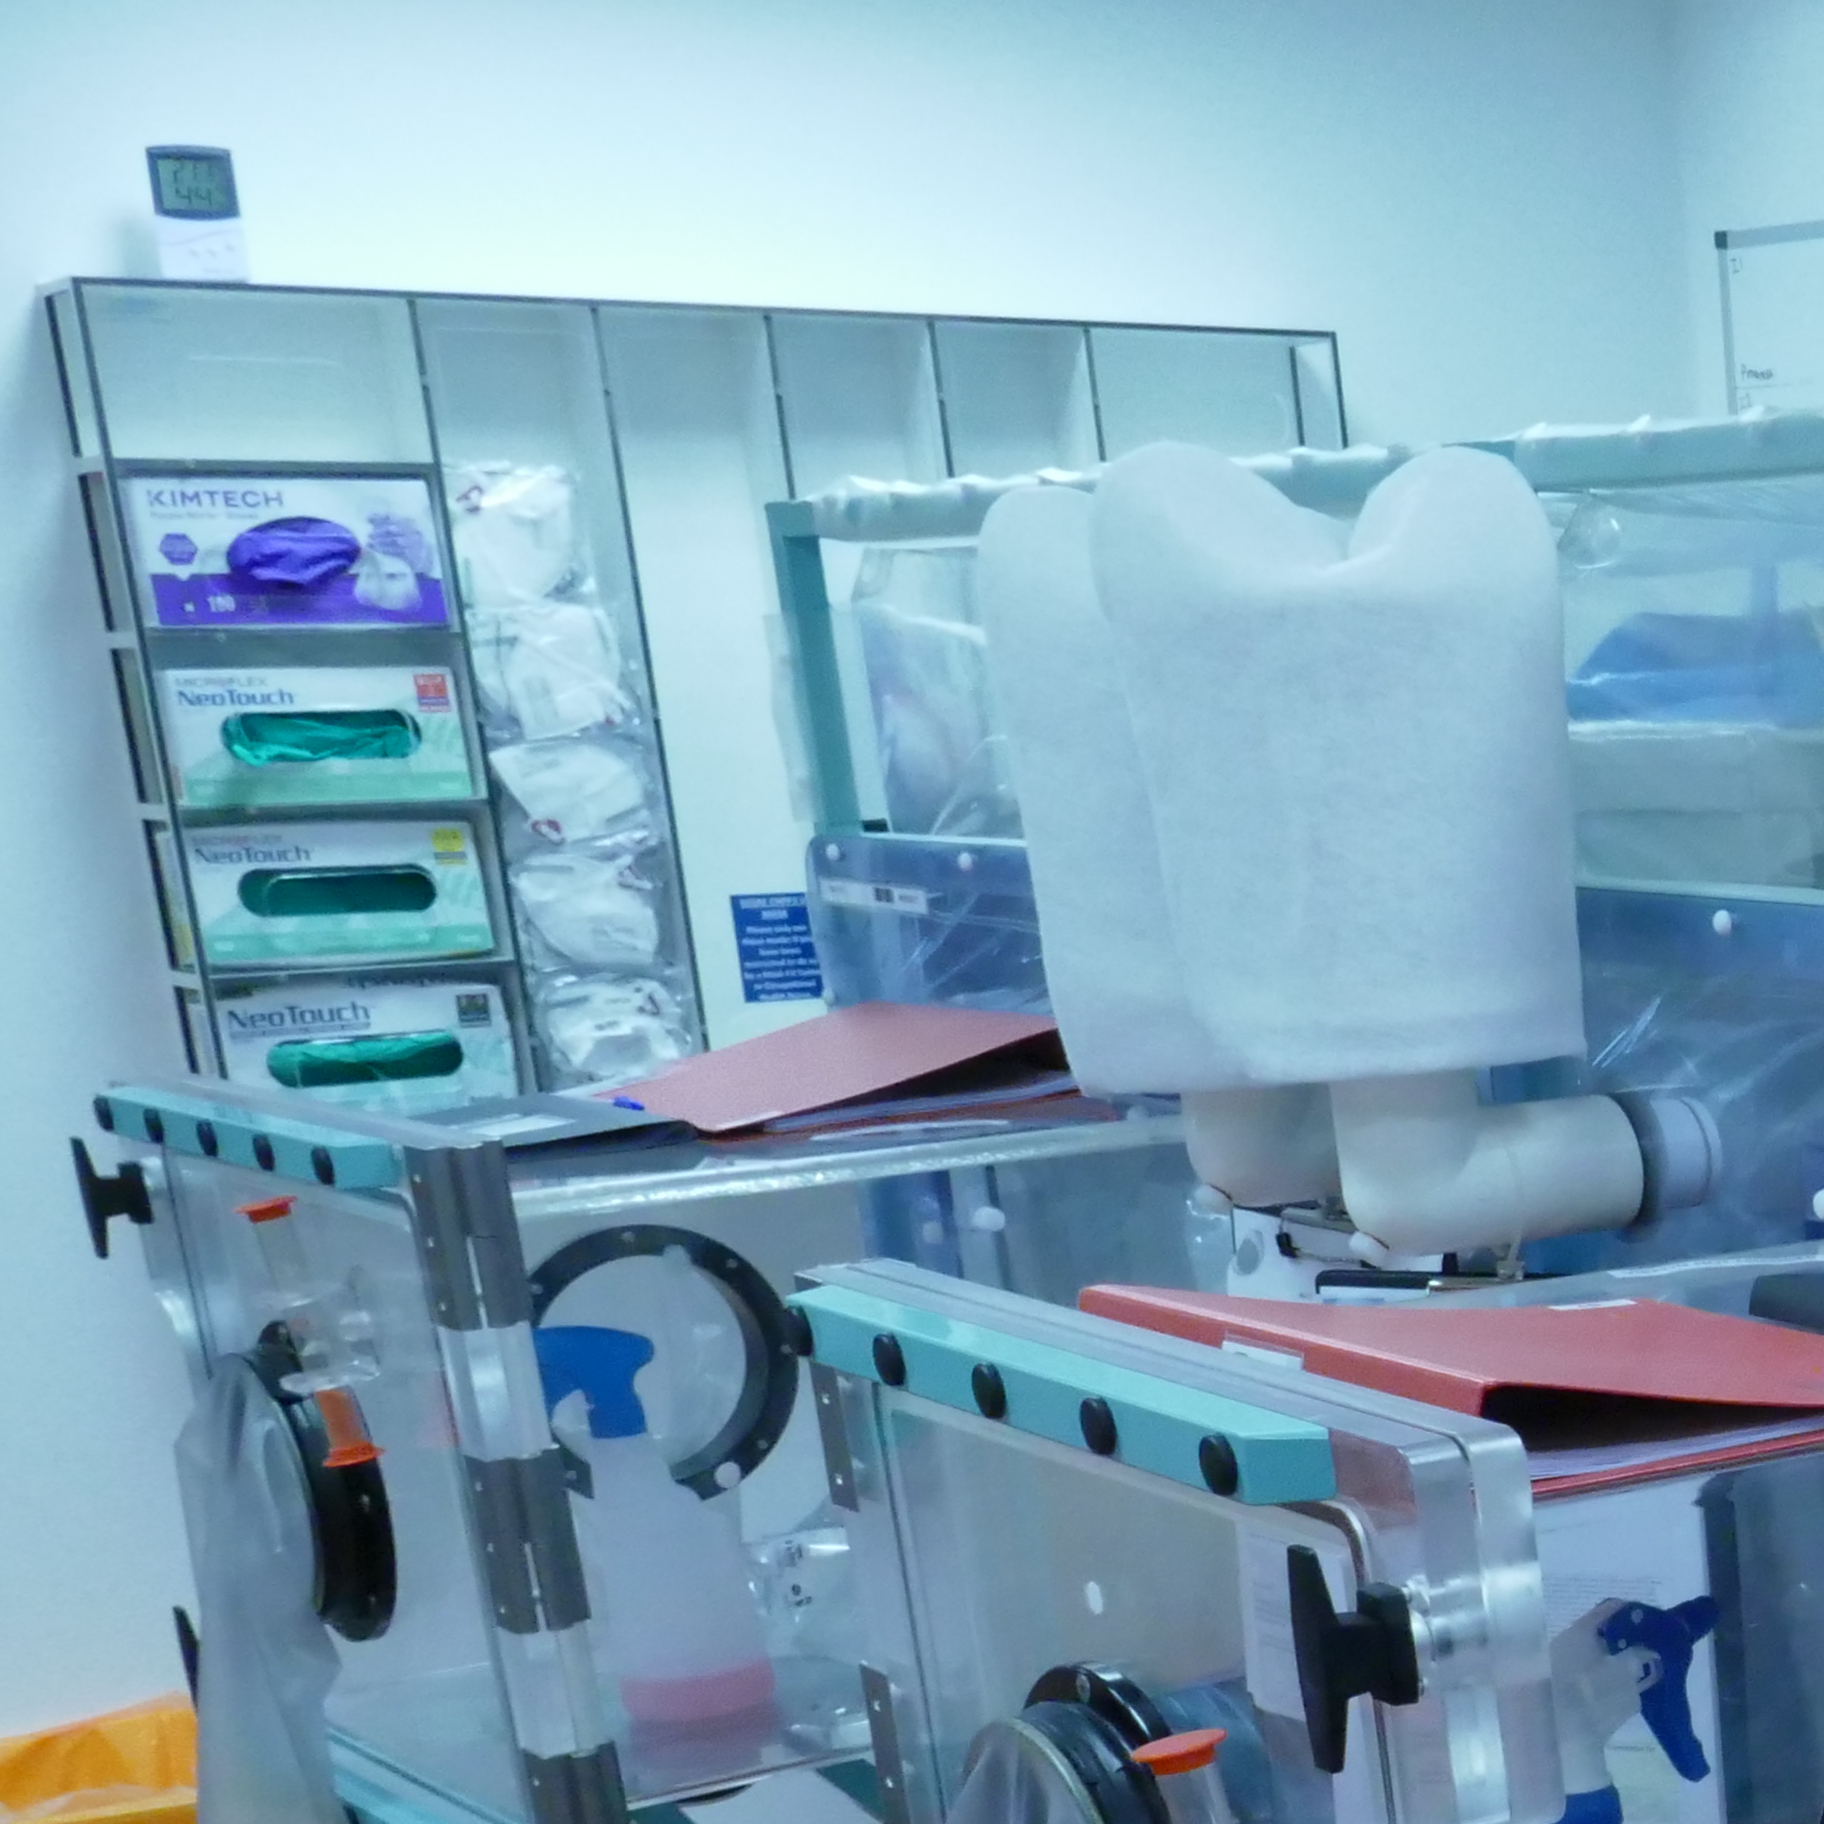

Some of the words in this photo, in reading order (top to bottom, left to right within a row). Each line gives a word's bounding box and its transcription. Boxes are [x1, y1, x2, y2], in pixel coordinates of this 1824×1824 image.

[147, 489, 284, 509] KIMTECH
[176, 688, 295, 707] NeoTouch
[194, 846, 312, 864] NeoTouch
[227, 1001, 371, 1029] NeoTouch
